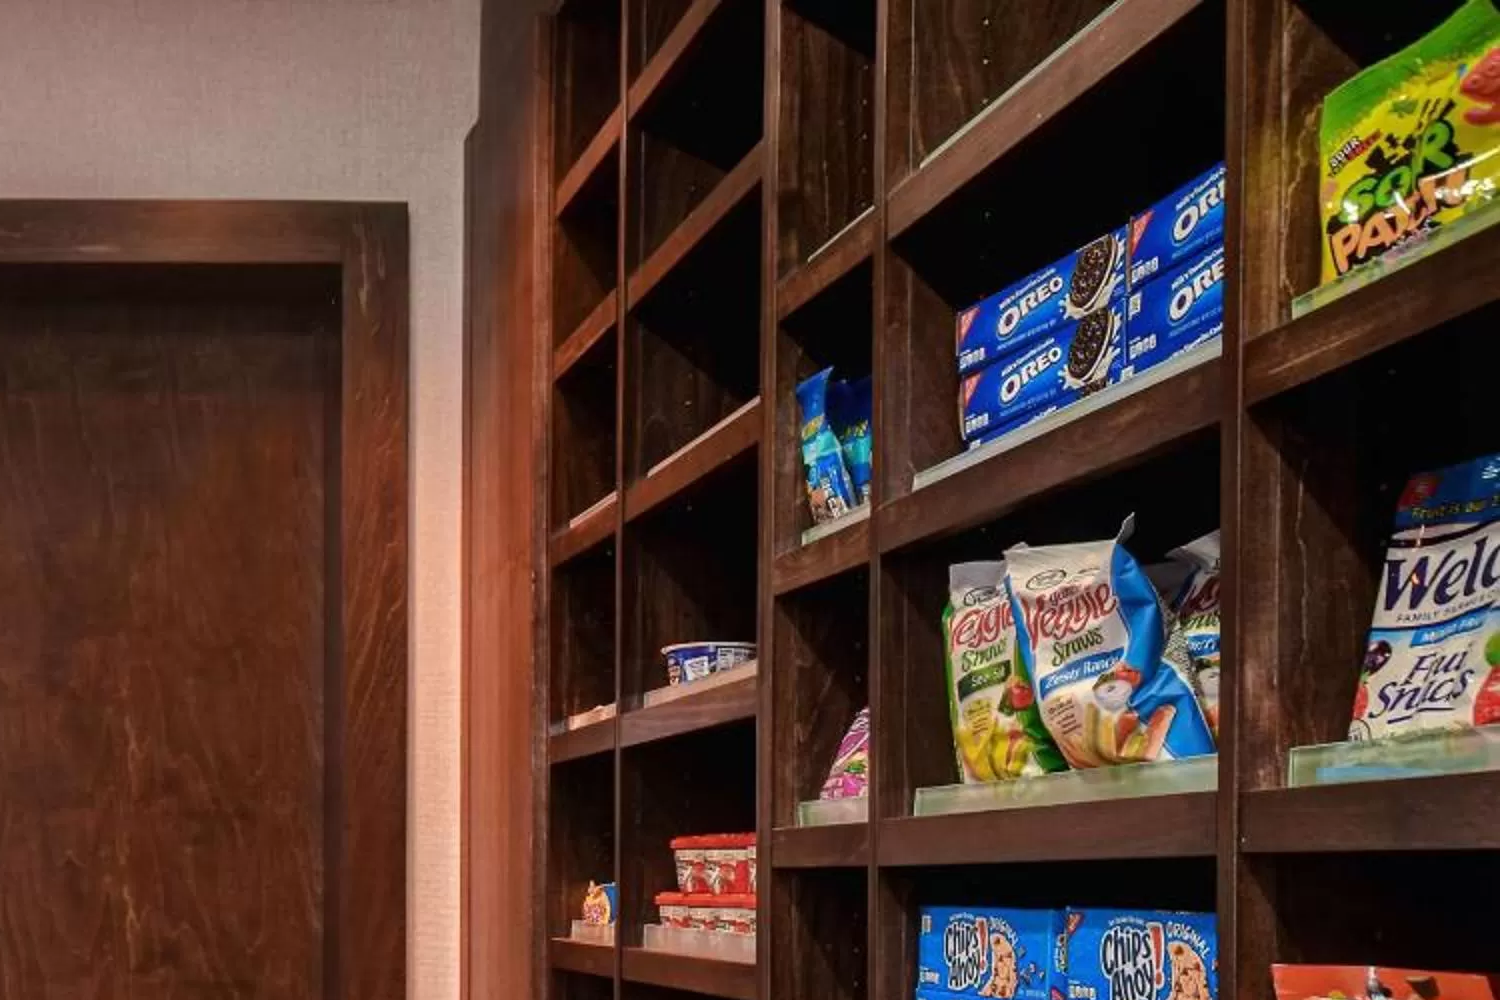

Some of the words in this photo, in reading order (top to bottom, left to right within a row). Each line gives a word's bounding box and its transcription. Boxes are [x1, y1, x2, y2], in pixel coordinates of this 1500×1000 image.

[997, 275, 1064, 338] OREO
[999, 346, 1062, 406] OREO
[1019, 582, 1117, 650] Veggie
[1051, 625, 1105, 667] Straws
[1101, 925, 1152, 975] Chips
